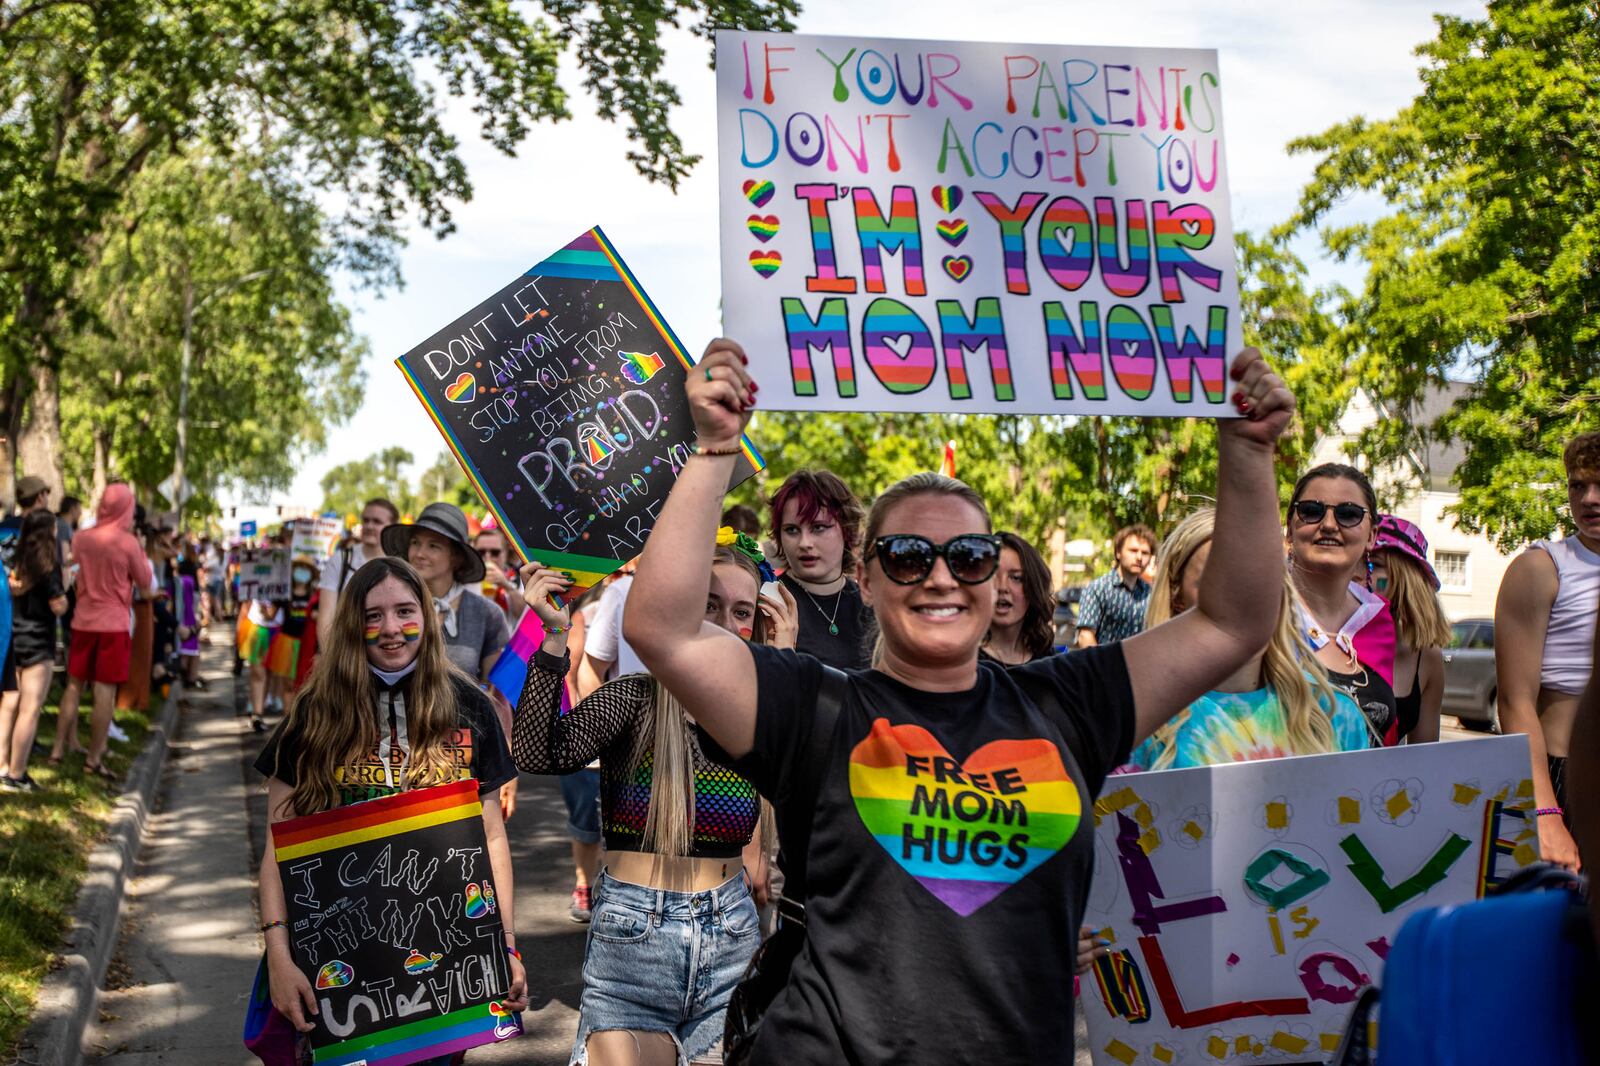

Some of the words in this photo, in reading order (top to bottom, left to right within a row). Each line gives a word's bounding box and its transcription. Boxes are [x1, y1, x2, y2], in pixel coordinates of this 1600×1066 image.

[742, 40, 795, 104] IF
[816, 47, 973, 110] YOUR
[1004, 55, 1218, 132] PARENTS
[739, 108, 910, 173] DON'T
[937, 117, 1131, 187] ACCEPT
[1140, 133, 1218, 192] YOU
[795, 183, 927, 296] I'M
[973, 190, 1222, 303] YOUR
[424, 313, 497, 380] DONT
[502, 275, 549, 327] LET
[489, 315, 577, 387] ANYONE
[781, 296, 1015, 401] MOM
[1042, 301, 1228, 404] NOW
[471, 390, 520, 442] STOP
[524, 357, 569, 395] YOU
[575, 312, 637, 366] FROM
[531, 374, 610, 437] BEING
[517, 389, 662, 511] PROUD
[545, 509, 582, 549] OF
[905, 753, 1028, 796] FREE
[909, 784, 1029, 827] MOM
[290, 857, 322, 909] I
[337, 843, 482, 895] CAN'T
[901, 823, 1030, 870] HUGS
[1115, 798, 1526, 936] LOVE
[294, 896, 353, 932] EVEN
[296, 893, 471, 965] THINK
